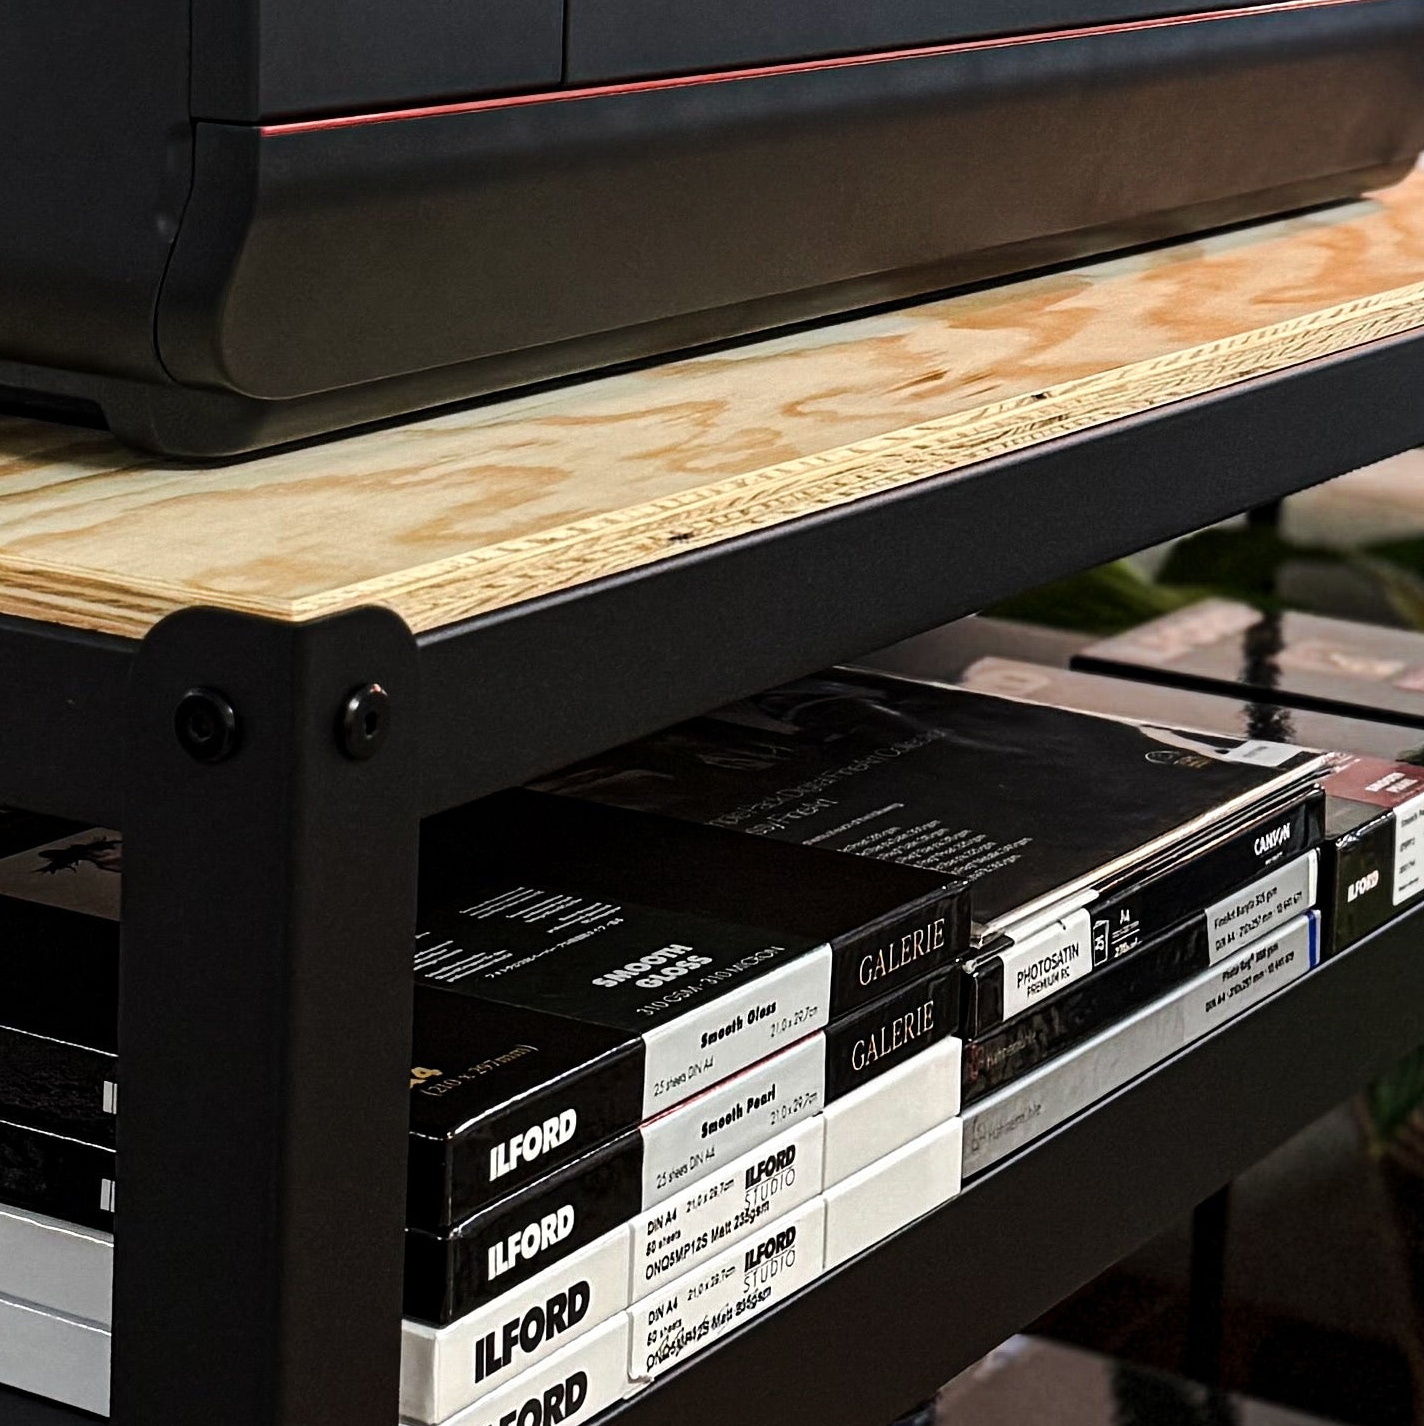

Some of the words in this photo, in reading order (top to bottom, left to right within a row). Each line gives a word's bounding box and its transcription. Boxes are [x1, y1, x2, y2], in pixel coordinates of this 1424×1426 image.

[592, 943, 693, 988] SMOOTH
[636, 954, 713, 988] GLOSS
[859, 919, 945, 987] GALERIE
[1017, 943, 1080, 987] PHOTOSATIN
[701, 1019, 743, 1049] Smooth
[748, 1002, 776, 1024] Gloss
[851, 1001, 934, 1071] GALERIE
[701, 1107, 743, 1139] Smooth
[747, 1084, 776, 1114] Pearl
[489, 1109, 577, 1181] ILFORD
[745, 1144, 796, 1190] ILFORD
[744, 1169, 796, 1210] STUDIO
[487, 1204, 575, 1280] ILFORD
[647, 1215, 664, 1235] DIN
[744, 1226, 796, 1272] ILFORD
[744, 1249, 796, 1293] STUDIO
[475, 1280, 590, 1383] ILFORD
